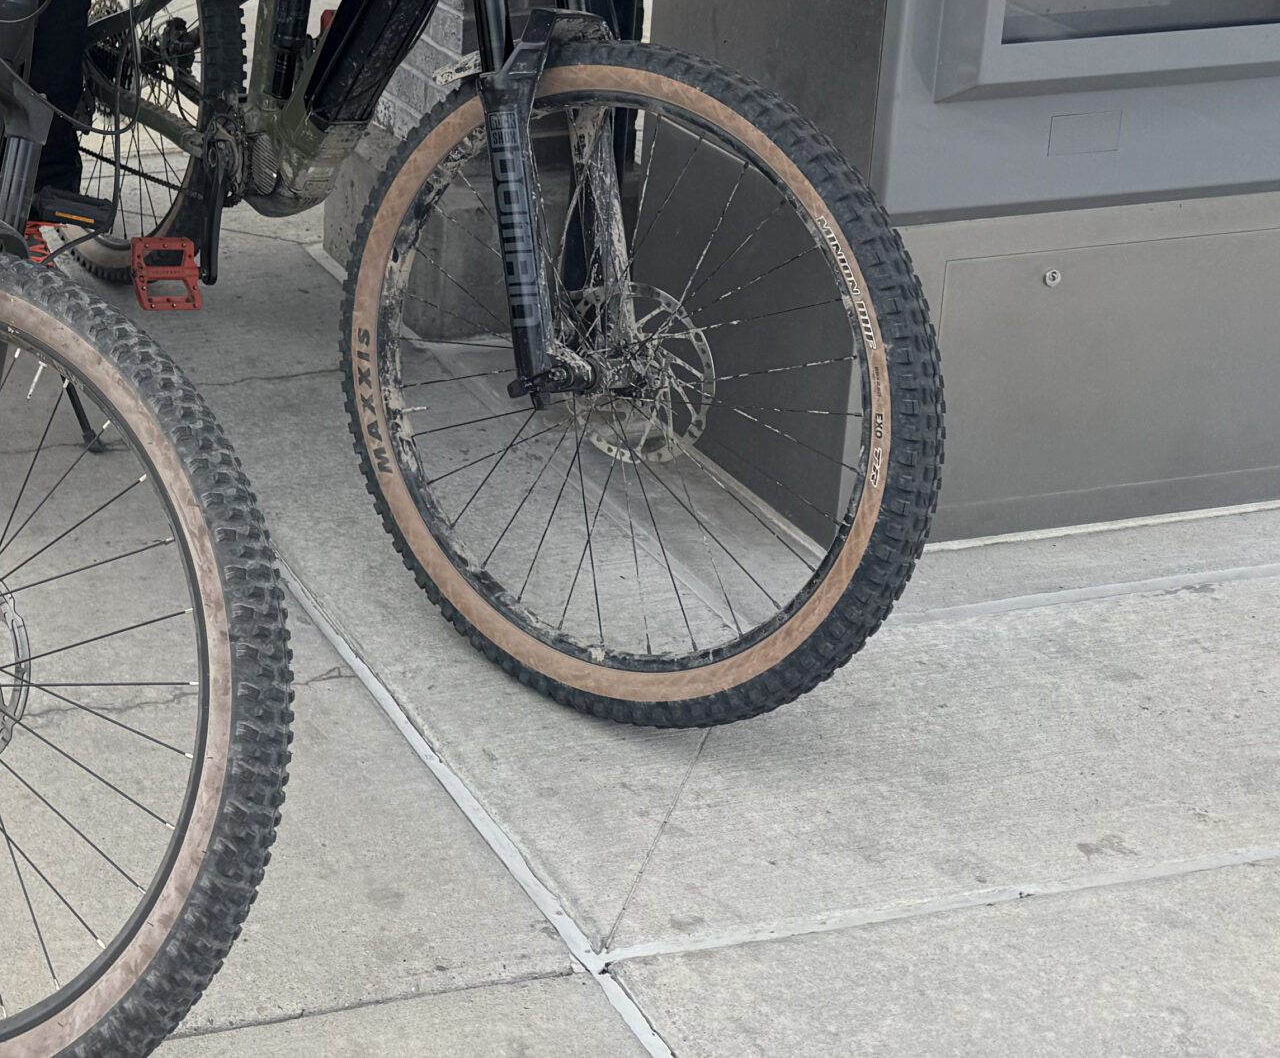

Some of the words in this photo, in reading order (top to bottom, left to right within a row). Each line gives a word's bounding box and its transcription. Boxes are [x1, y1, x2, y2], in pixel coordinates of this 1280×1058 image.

[490, 114, 517, 130] ROCK
[492, 130, 518, 146] SHOX
[492, 149, 542, 328] DOMAIN
[816, 215, 861, 295] MINION
[357, 327, 394, 474] MAXXIS
[874, 413, 884, 439] EXO
[870, 446, 883, 487] TR
